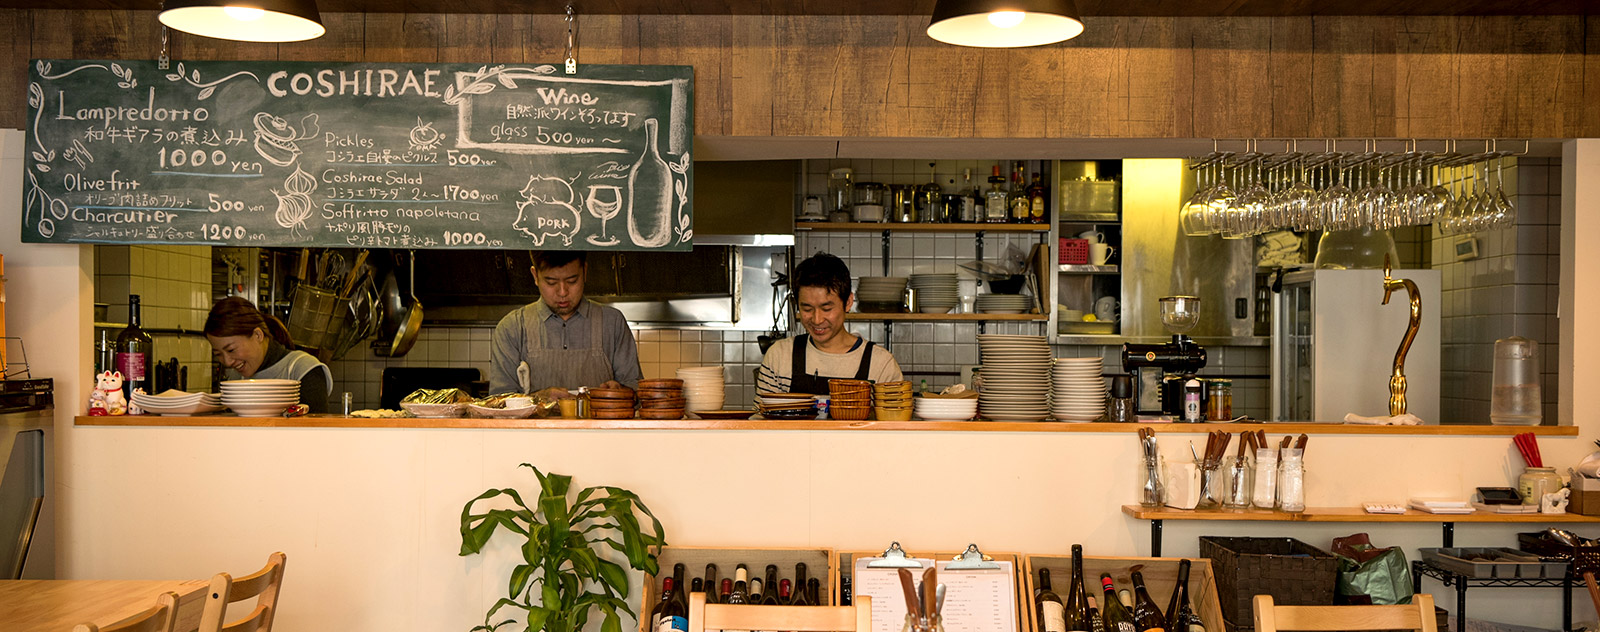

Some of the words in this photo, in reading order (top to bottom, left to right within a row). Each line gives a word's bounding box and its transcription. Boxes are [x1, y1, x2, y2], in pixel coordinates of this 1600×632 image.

[267, 69, 441, 98] COSHIRAE
[536, 87, 599, 106] Wine
[56, 86, 209, 129] Lampredotto
[325, 132, 374, 148] Pickles
[490, 122, 528, 142] glass
[536, 125, 573, 144] 500
[575, 135, 595, 144] yen
[446, 150, 481, 166] 500
[231, 161, 262, 174] yen
[64, 173, 105, 192] Olive
[106, 169, 140, 191] frit
[322, 169, 382, 184] Coshirae
[385, 170, 423, 185] Salad
[208, 193, 244, 212] 500
[247, 204, 265, 213] yen
[480, 192, 499, 202] yen
[71, 208, 178, 223] Charcutier
[321, 203, 388, 220] Soffritto
[396, 205, 480, 221] napoletana
[537, 217, 570, 229] PORK
[200, 223, 246, 241] 1200
[248, 232, 266, 241] yen
[443, 230, 486, 246] 1000
[486, 239, 504, 247] yen
